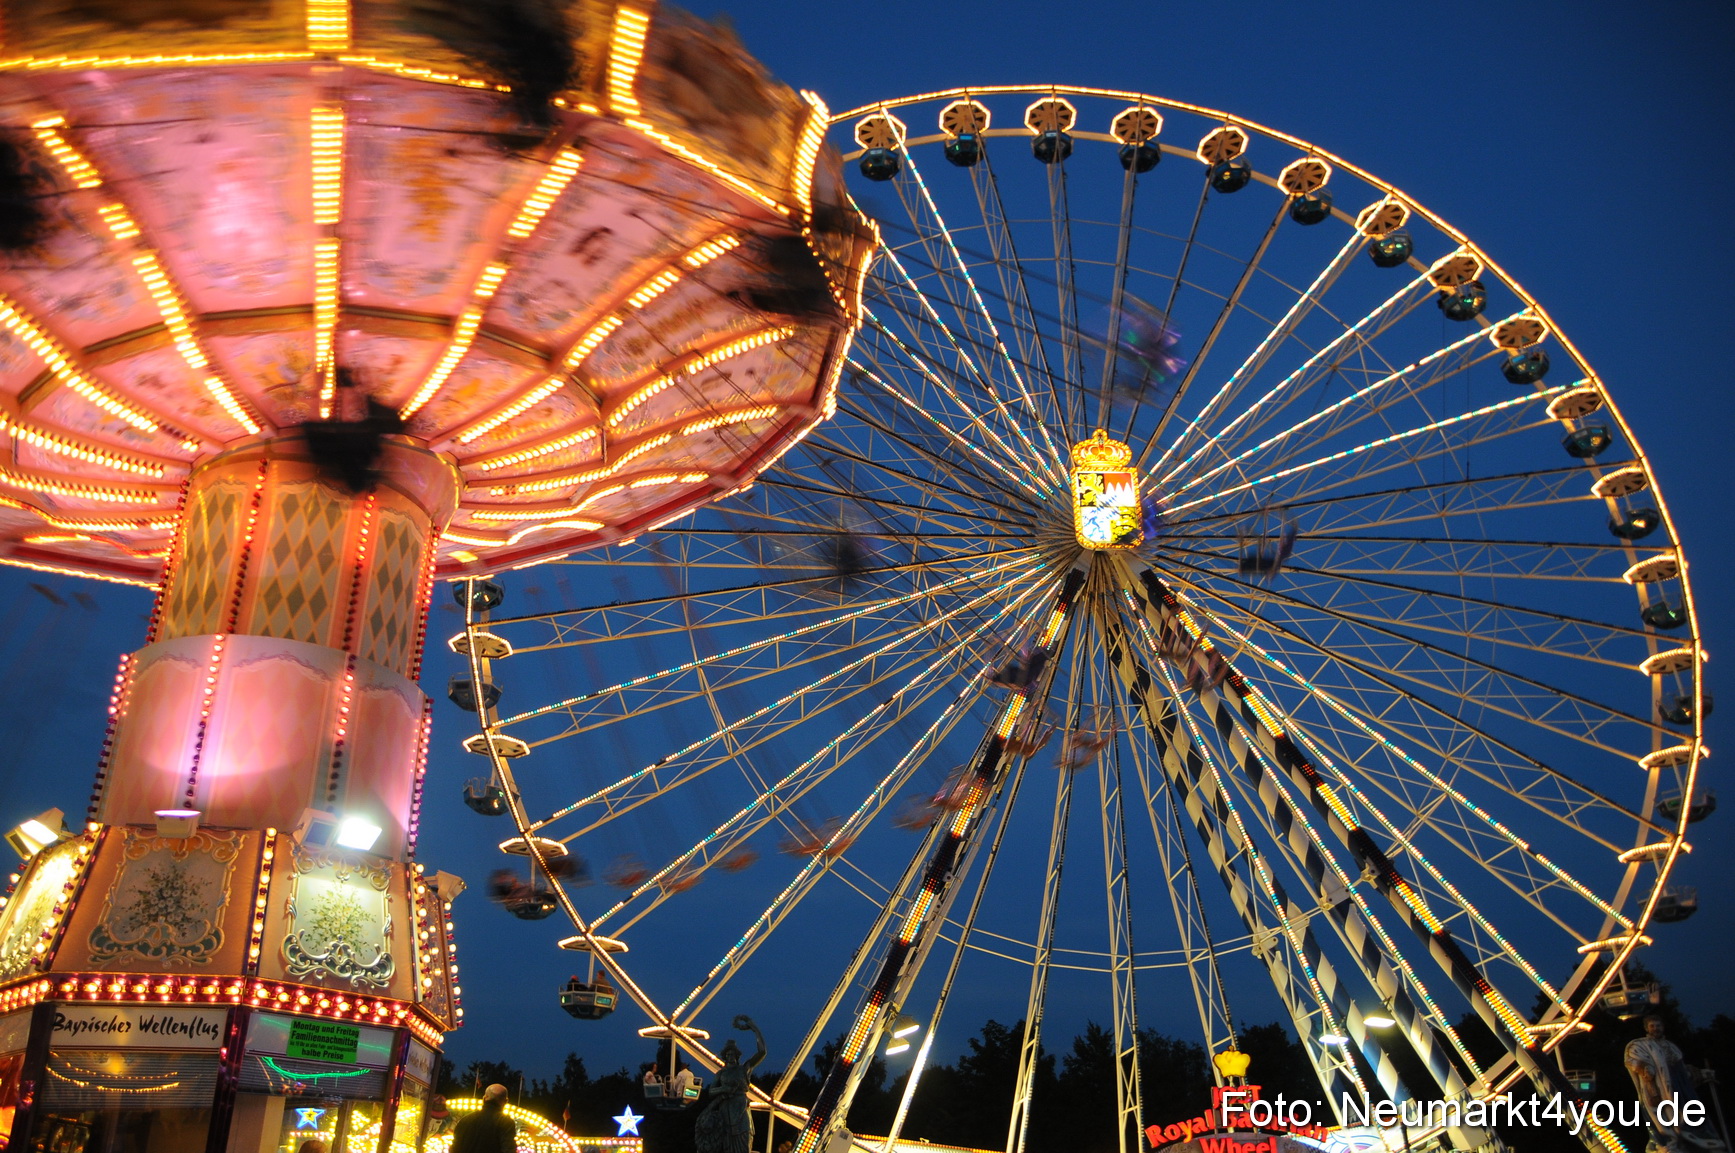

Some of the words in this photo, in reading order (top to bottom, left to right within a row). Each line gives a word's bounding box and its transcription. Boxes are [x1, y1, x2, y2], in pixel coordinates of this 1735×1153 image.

[51, 1012, 132, 1037] Bayrischer
[139, 1014, 219, 1040] Wellenflug
[293, 1021, 320, 1033] Montag
[336, 1026, 360, 1038] Freitag
[291, 1030, 358, 1048] Familiennachmittag
[302, 1048, 321, 1057] halbe
[323, 1050, 344, 1060] Preise
[1211, 1085, 1262, 1109] JOST
[1144, 1109, 1215, 1149] Royal
[1198, 1136, 1279, 1153] Wheel
